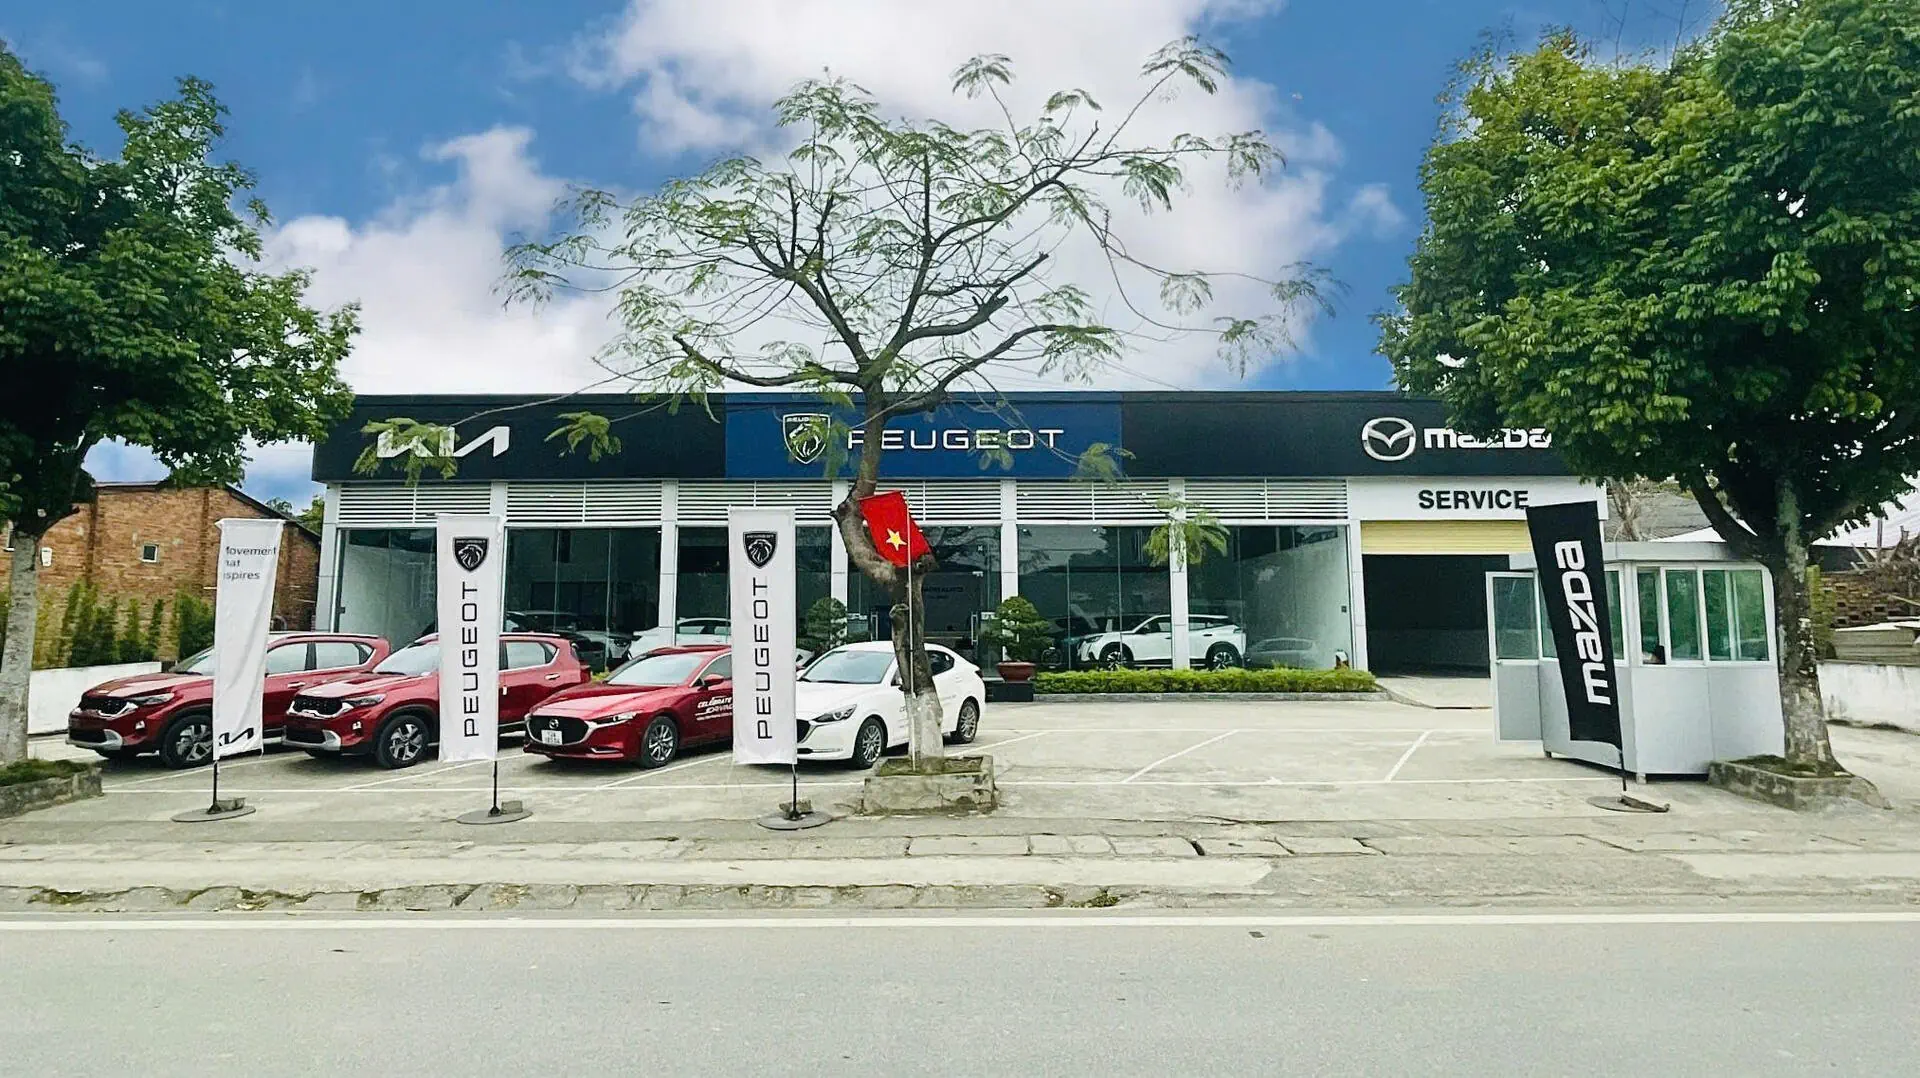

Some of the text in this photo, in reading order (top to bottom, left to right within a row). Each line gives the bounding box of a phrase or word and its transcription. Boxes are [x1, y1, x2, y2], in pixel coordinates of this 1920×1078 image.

[1418, 489, 1530, 510] SERVICE
[462, 581, 480, 737] PEUGEOT
[752, 577, 773, 739] PEUGEOT
